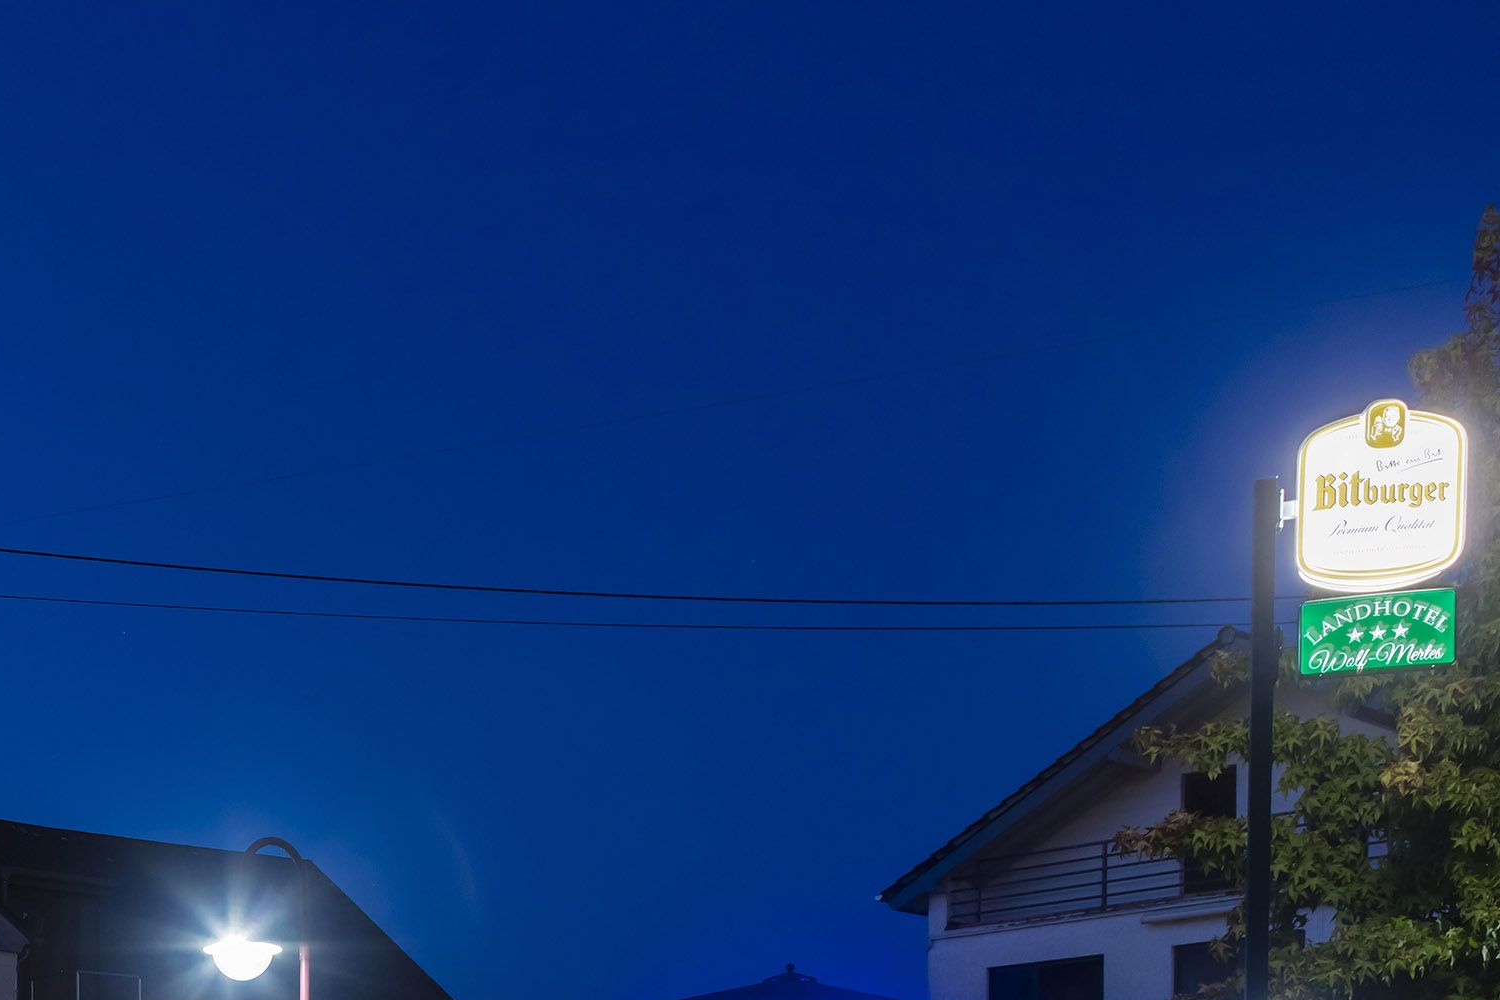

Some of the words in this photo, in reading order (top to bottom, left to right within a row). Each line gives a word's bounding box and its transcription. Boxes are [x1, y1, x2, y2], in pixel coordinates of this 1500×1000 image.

[1312, 470, 1450, 511] Bitburger
[1330, 519, 1380, 536] Premium
[1303, 600, 1449, 646] LANDHOTEL
[1308, 642, 1444, 673] Wolf-Mertes
